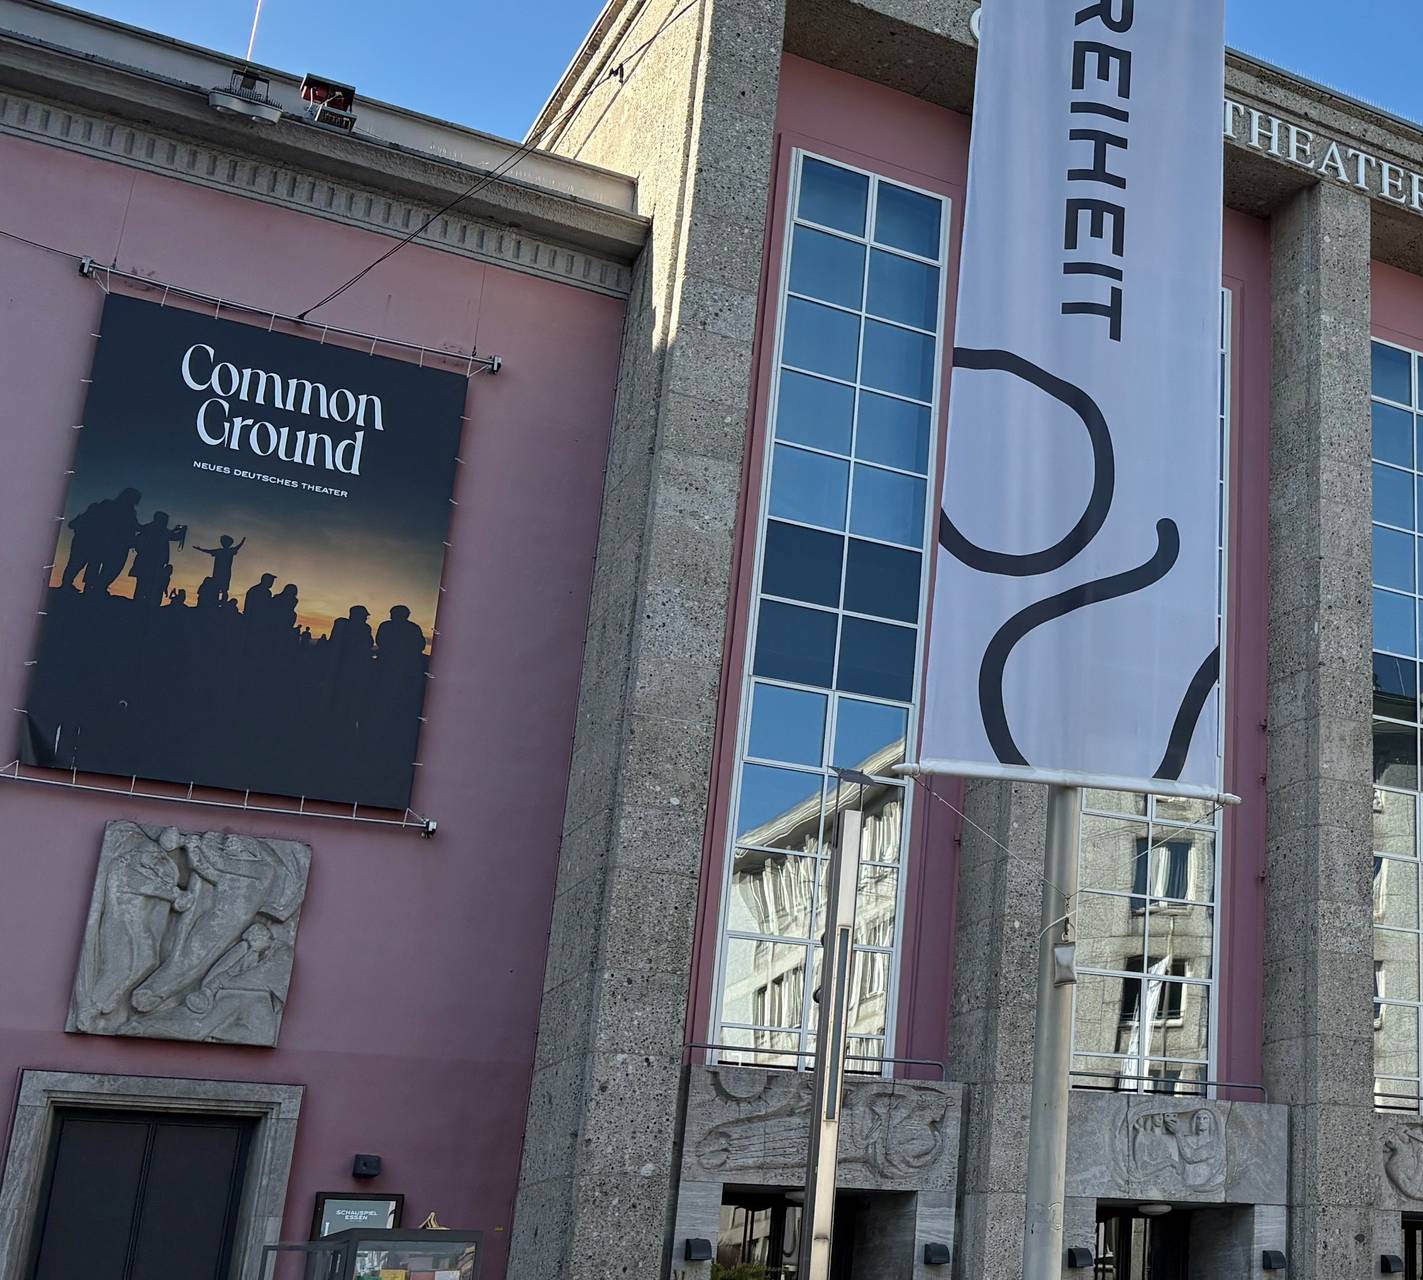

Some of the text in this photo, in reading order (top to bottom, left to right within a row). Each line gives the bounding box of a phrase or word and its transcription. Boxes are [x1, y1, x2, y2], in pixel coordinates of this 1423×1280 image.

[181, 343, 385, 431] Common
[196, 398, 364, 476] Ground
[192, 460, 349, 498] NEUES DEUTSCHES THEATER
